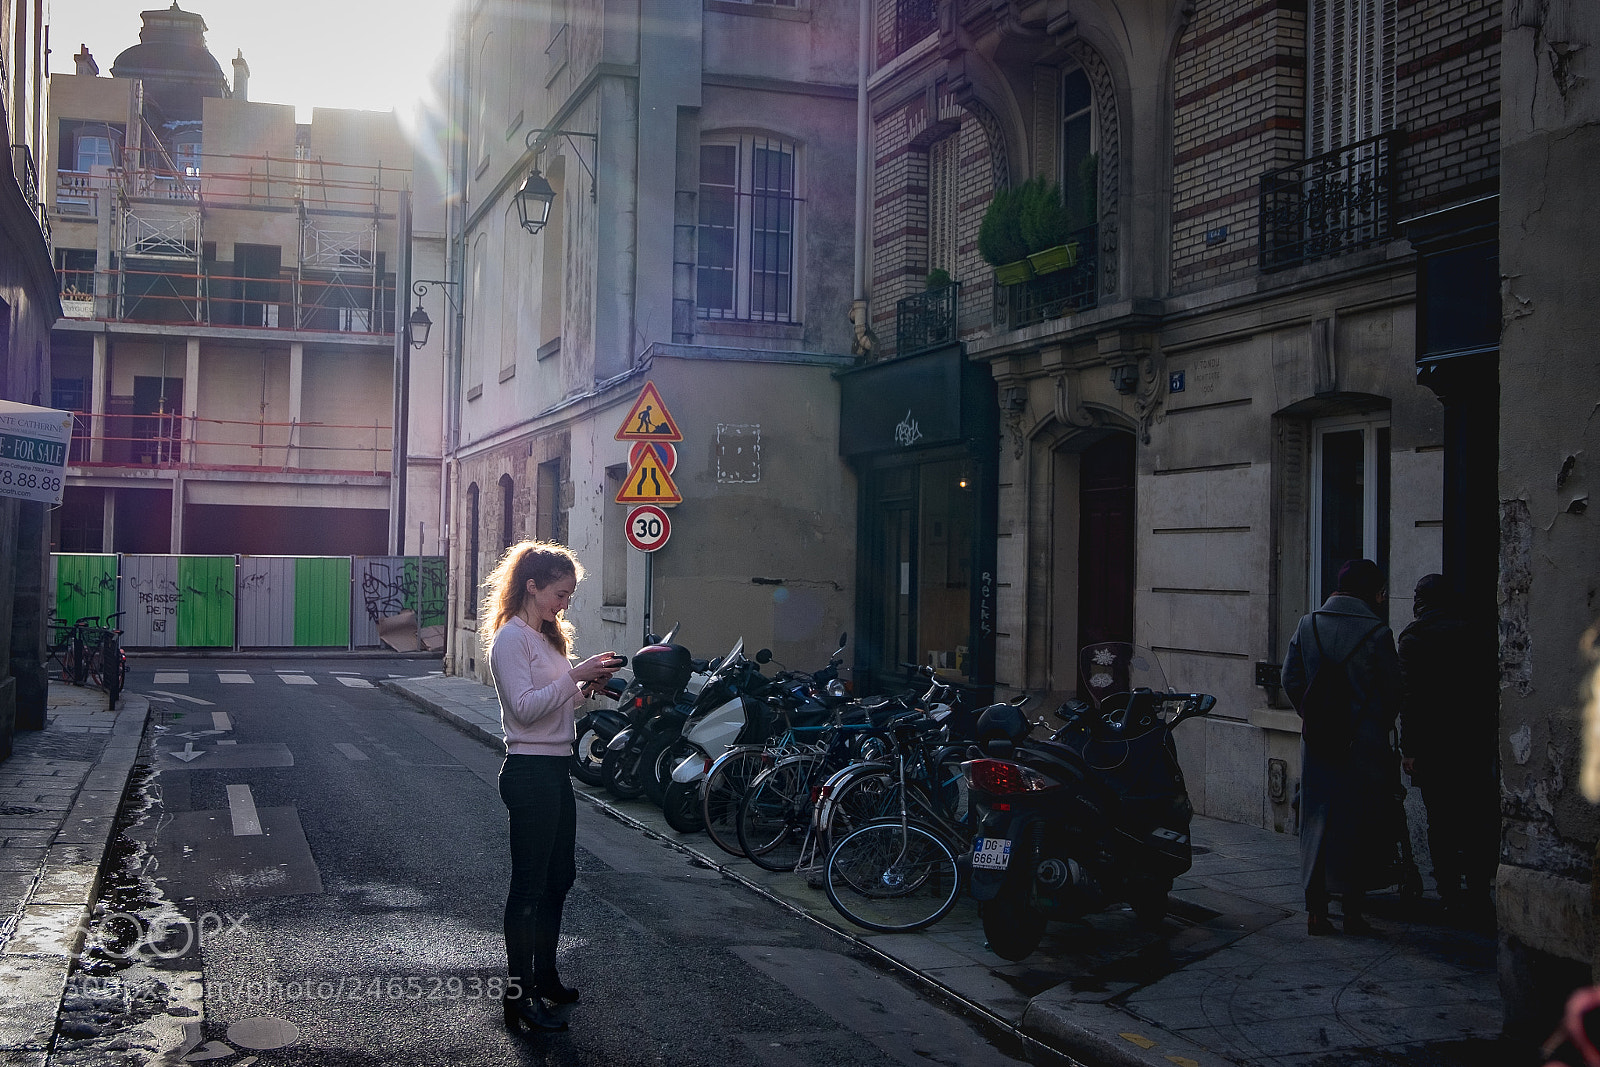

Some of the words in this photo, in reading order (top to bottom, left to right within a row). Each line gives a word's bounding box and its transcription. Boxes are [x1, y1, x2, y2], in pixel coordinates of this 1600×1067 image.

[18, 419, 63, 433] CATHERINE
[13, 439, 34, 460] FOR
[37, 442, 63, 464] SALE
[636, 518, 661, 537] 30
